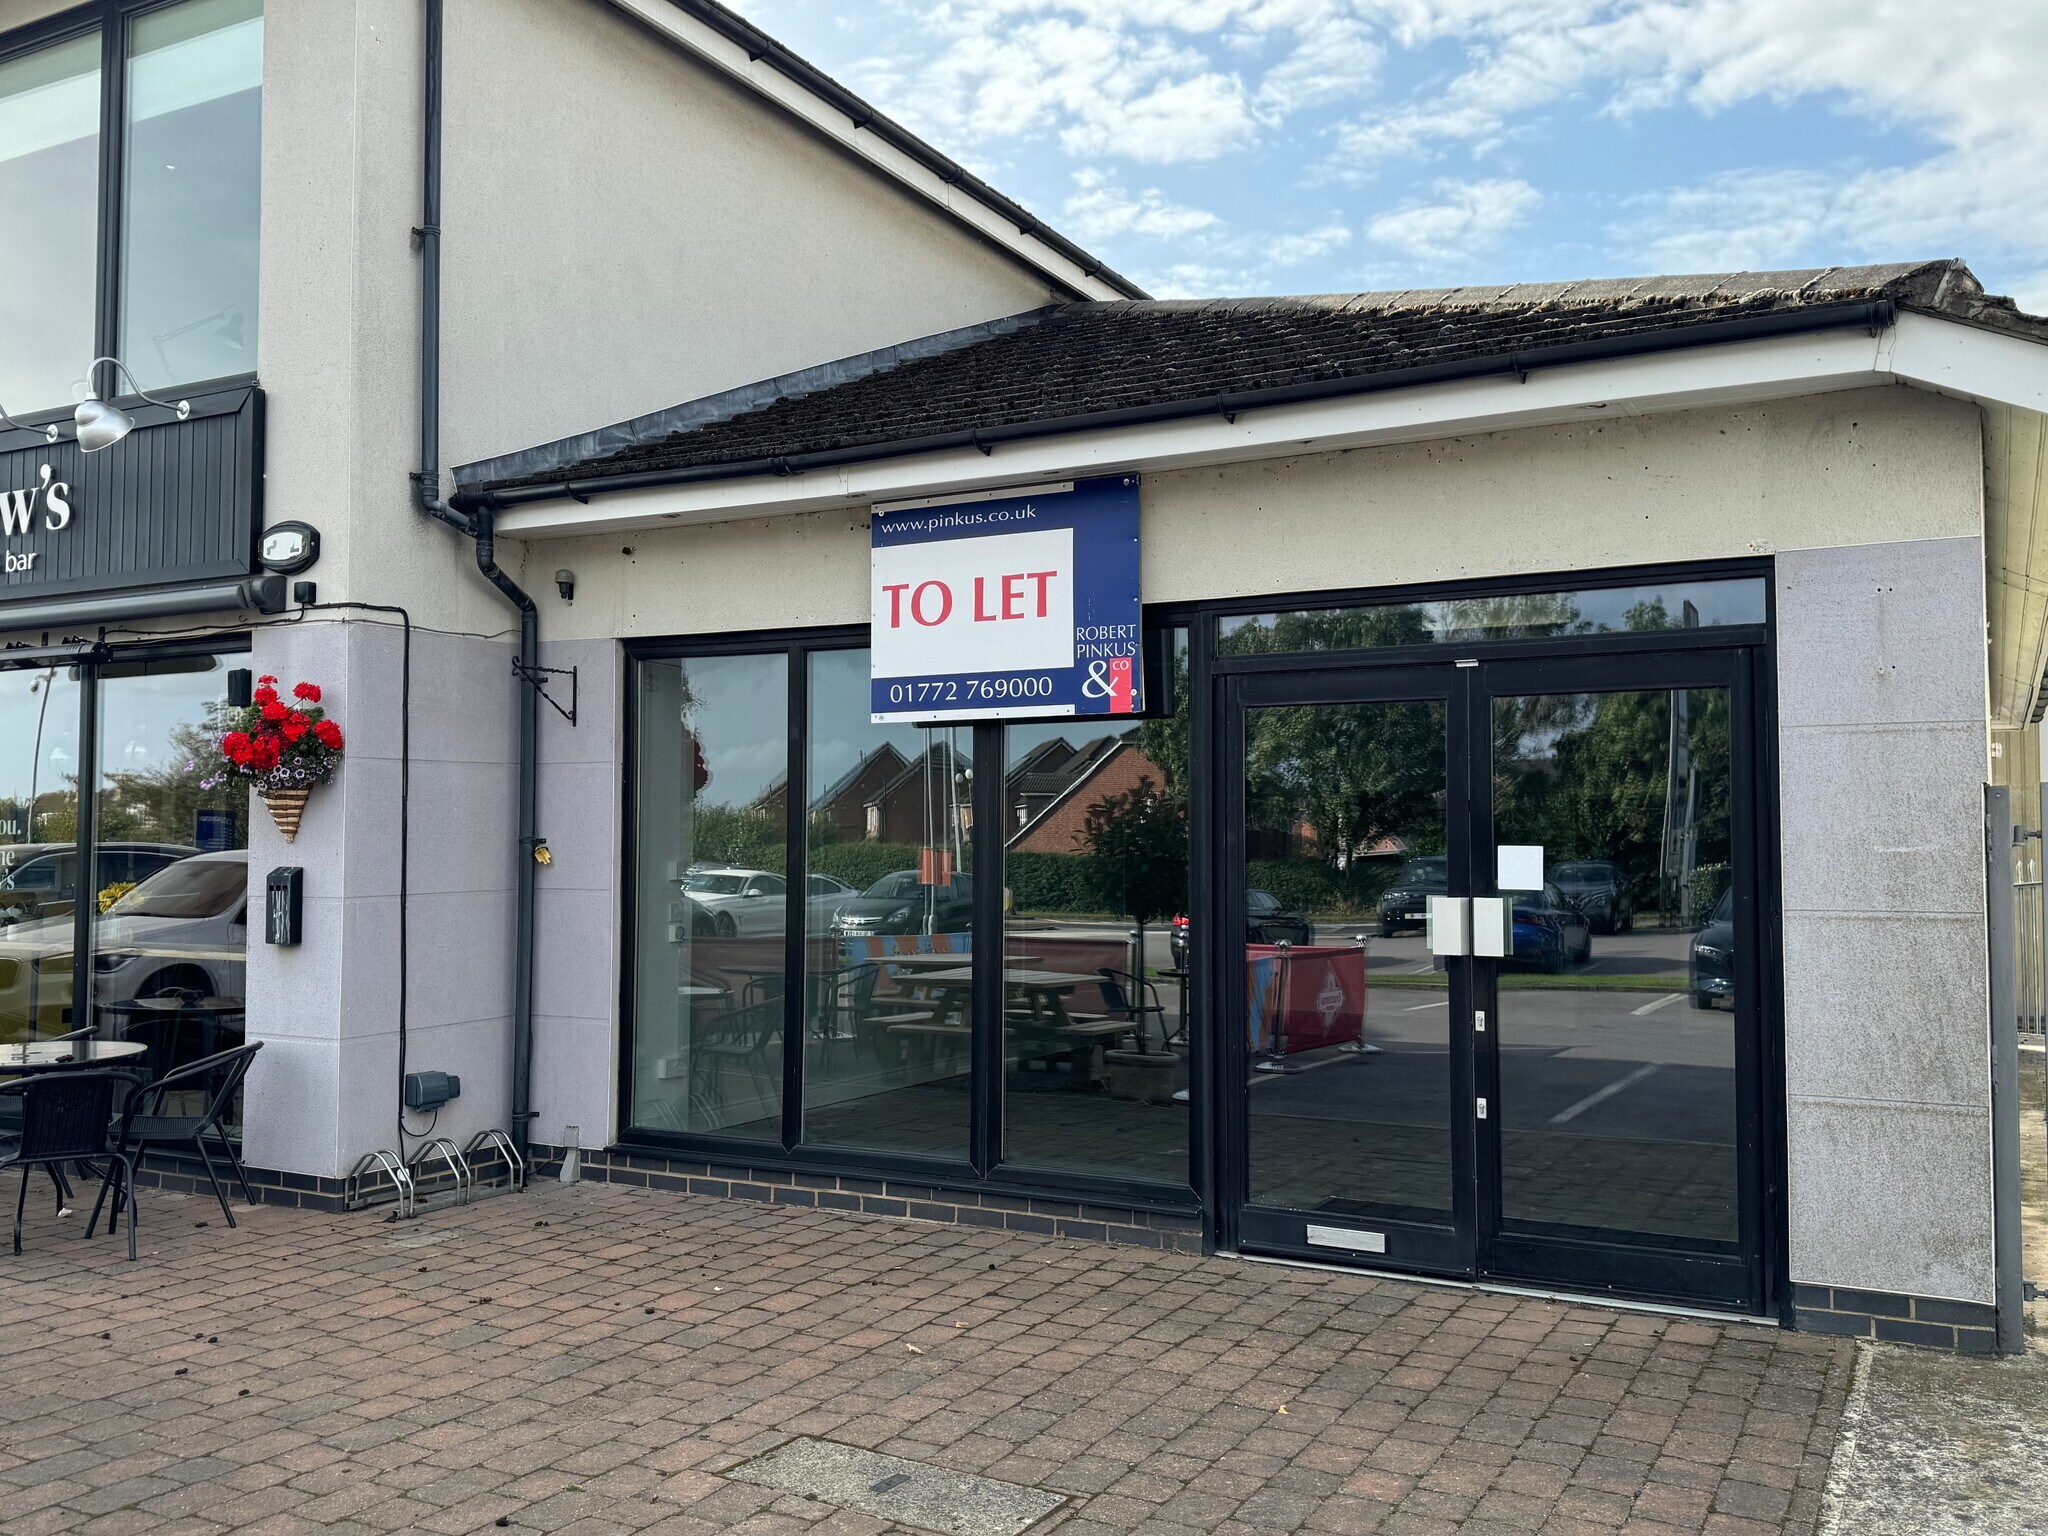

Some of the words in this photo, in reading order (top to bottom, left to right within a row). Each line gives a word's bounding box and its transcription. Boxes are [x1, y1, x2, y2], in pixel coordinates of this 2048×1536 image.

[881, 504, 1036, 533] www.pinkus.co.uk
[6, 550, 37, 572] bar
[882, 580, 953, 628] TO
[974, 570, 1058, 622] LET
[1076, 624, 1137, 641] ROBERT
[1077, 641, 1136, 659] PINKUS
[889, 681, 957, 703] 01772
[966, 676, 1053, 700] 769000
[1081, 660, 1119, 698] &
[1112, 660, 1130, 671] CO
